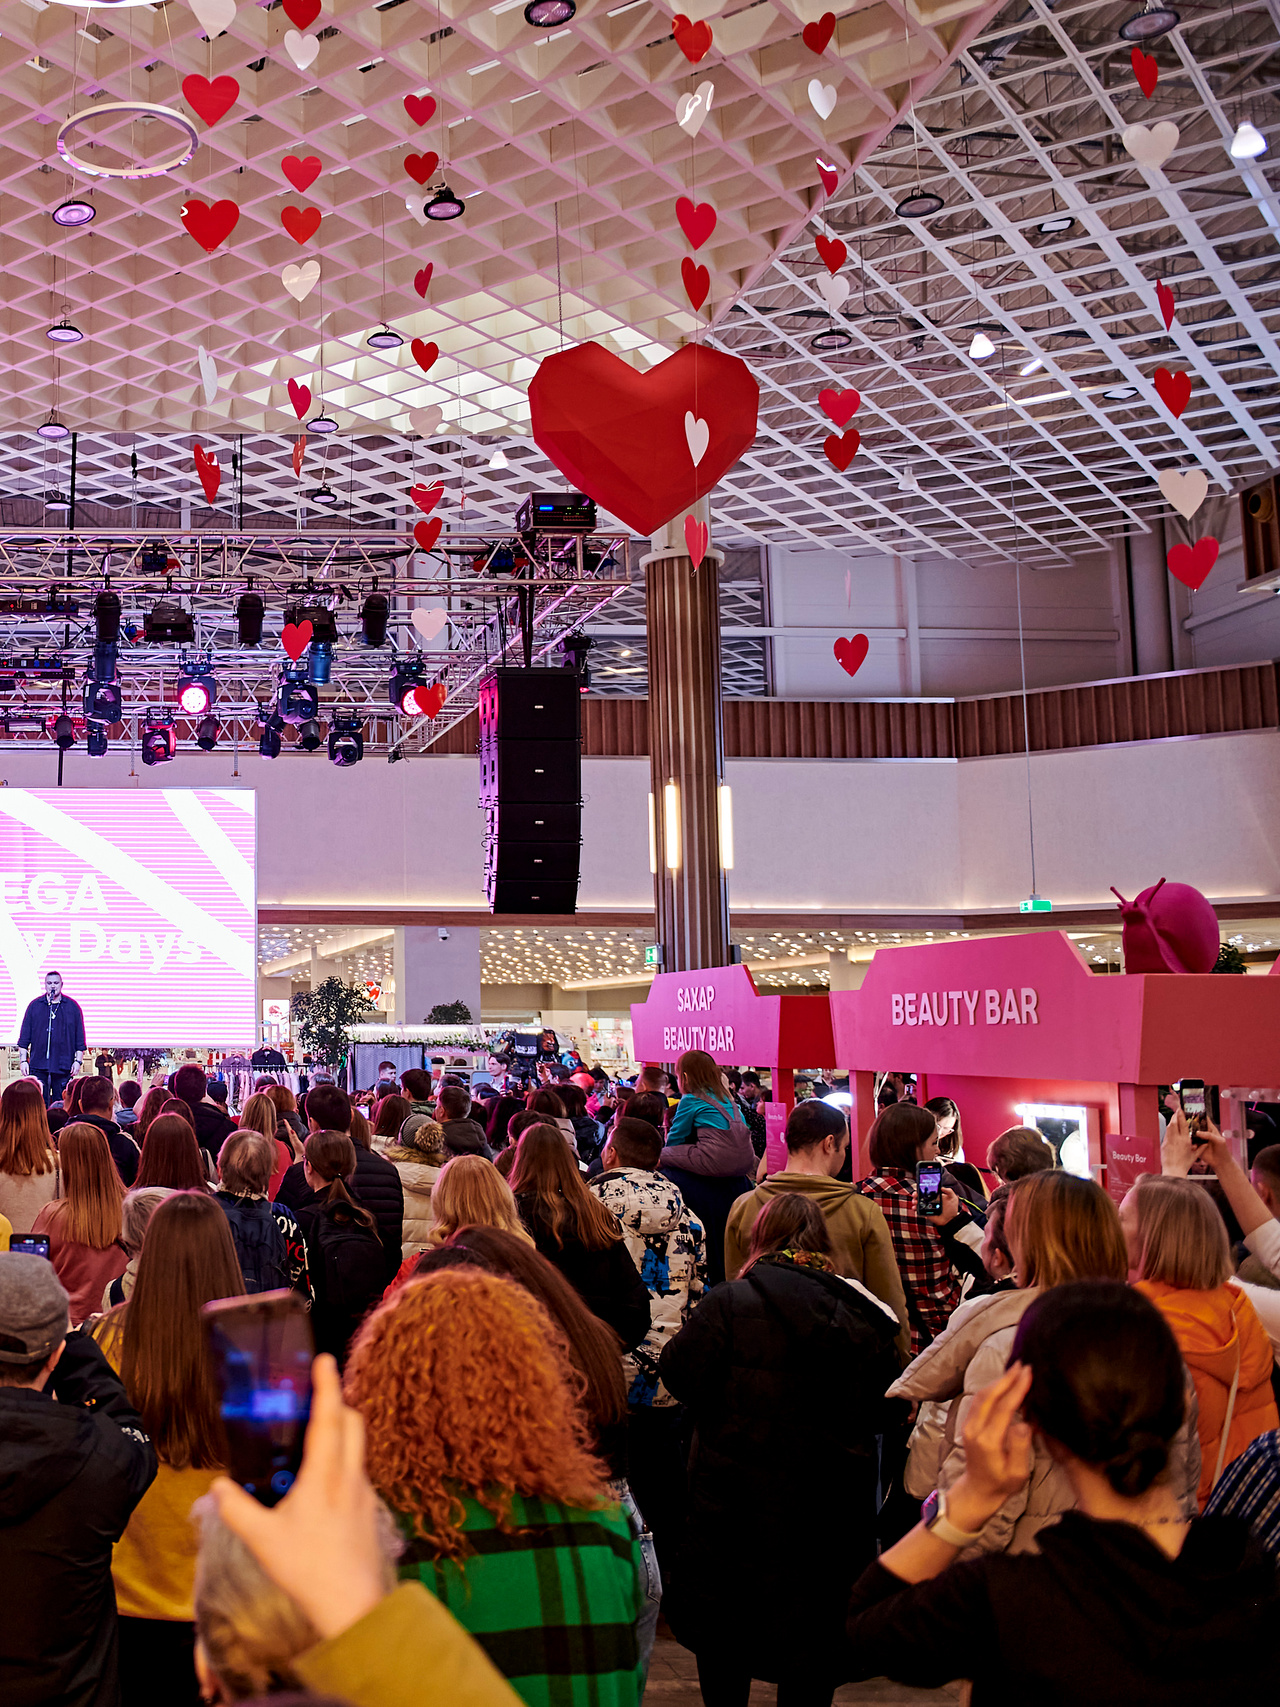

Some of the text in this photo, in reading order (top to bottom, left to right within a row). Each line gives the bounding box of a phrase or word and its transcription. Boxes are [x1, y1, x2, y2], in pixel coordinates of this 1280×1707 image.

[70, 922, 202, 974] Days
[891, 987, 1040, 1027] BEAUTY BAR
[663, 1025, 736, 1052] BEAUTY BAR
[1112, 1150, 1147, 1164] Beauty Bar
